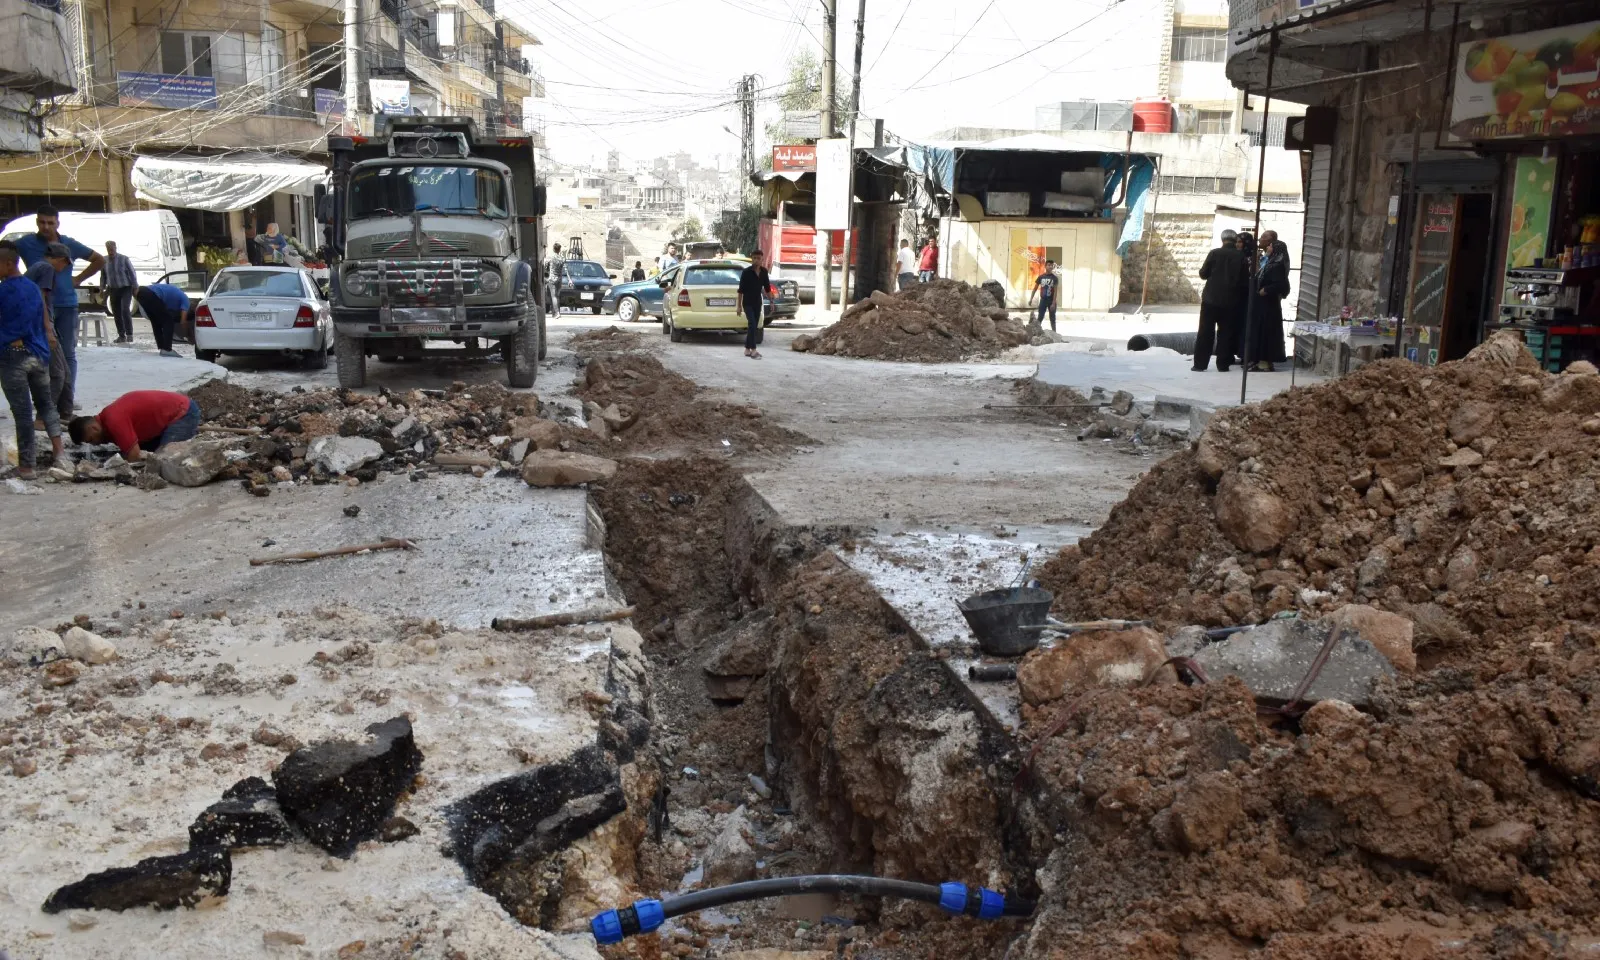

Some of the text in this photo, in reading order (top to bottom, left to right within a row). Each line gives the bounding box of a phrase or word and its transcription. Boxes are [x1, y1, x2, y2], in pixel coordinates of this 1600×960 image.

[1472, 120, 1507, 137] mina
[773, 147, 815, 165] صيدلية
[378, 166, 479, 177] SPORT
